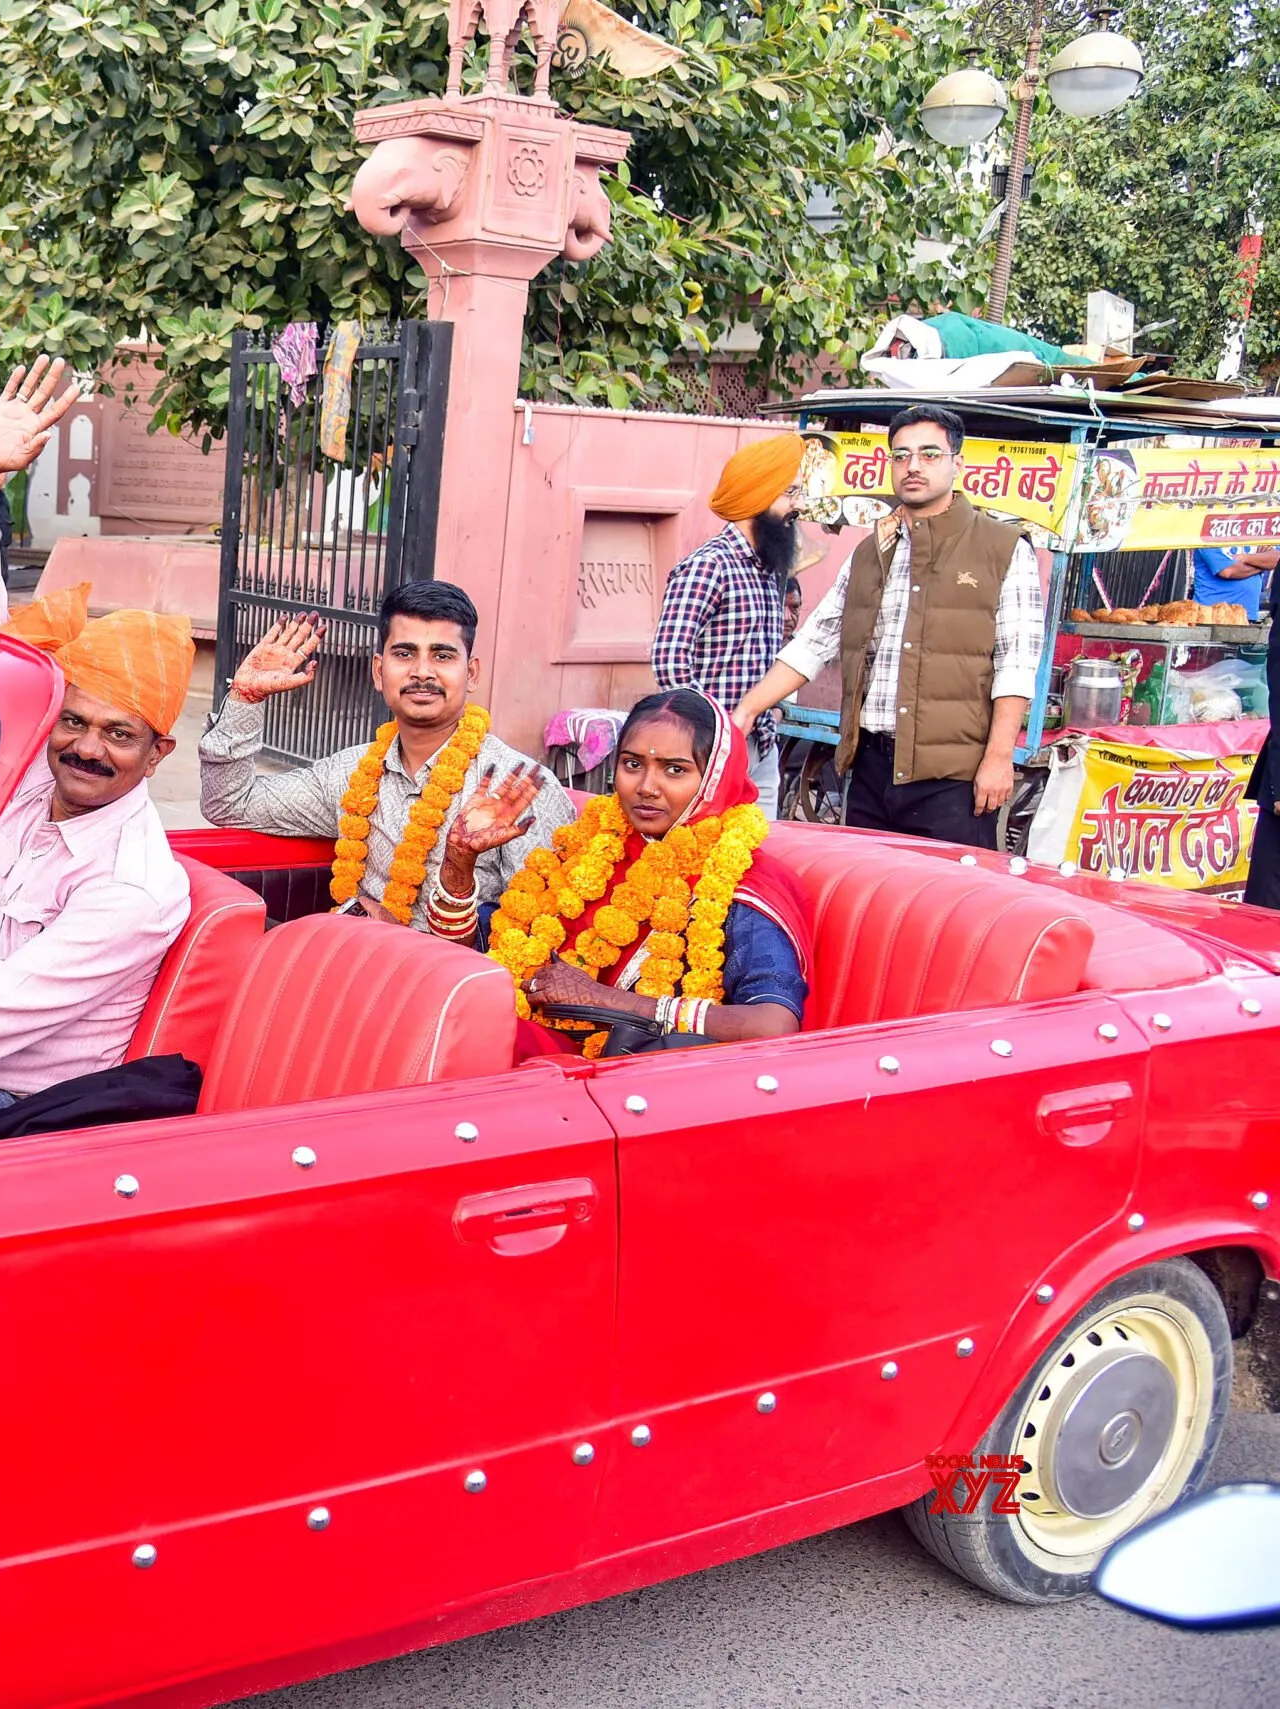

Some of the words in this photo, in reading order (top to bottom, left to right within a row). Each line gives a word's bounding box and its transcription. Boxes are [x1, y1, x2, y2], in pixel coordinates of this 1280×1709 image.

[844, 446, 888, 489] दही
[962, 456, 1013, 498] दही
[1018, 456, 1062, 512] बड़े
[1209, 518, 1244, 538] स्वाद
[1246, 518, 1268, 536] का
[1205, 760, 1236, 805] के
[1180, 785, 1246, 882] दही
